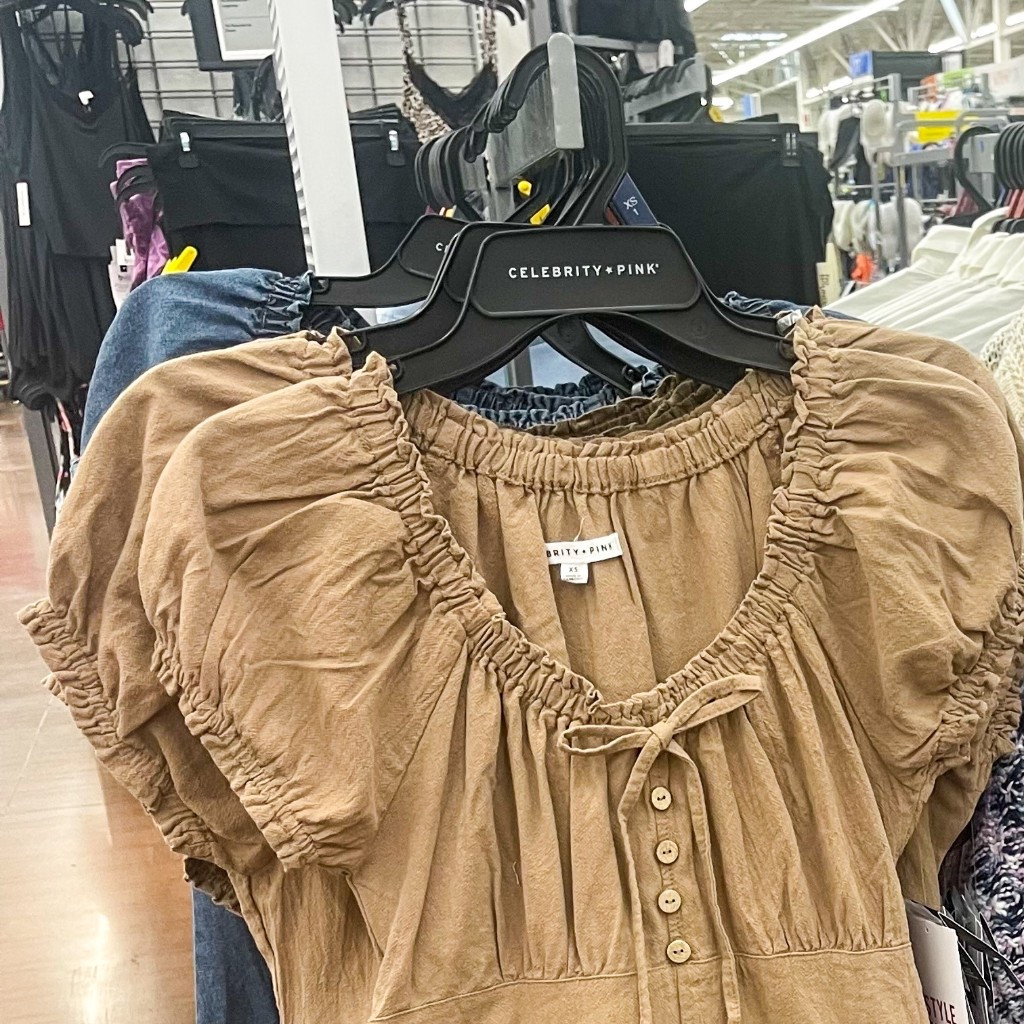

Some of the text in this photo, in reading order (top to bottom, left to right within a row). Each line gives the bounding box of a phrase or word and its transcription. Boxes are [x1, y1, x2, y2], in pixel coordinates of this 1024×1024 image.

[623, 196, 638, 210] XS
[508, 263, 659, 279] CELEBRITY PINK
